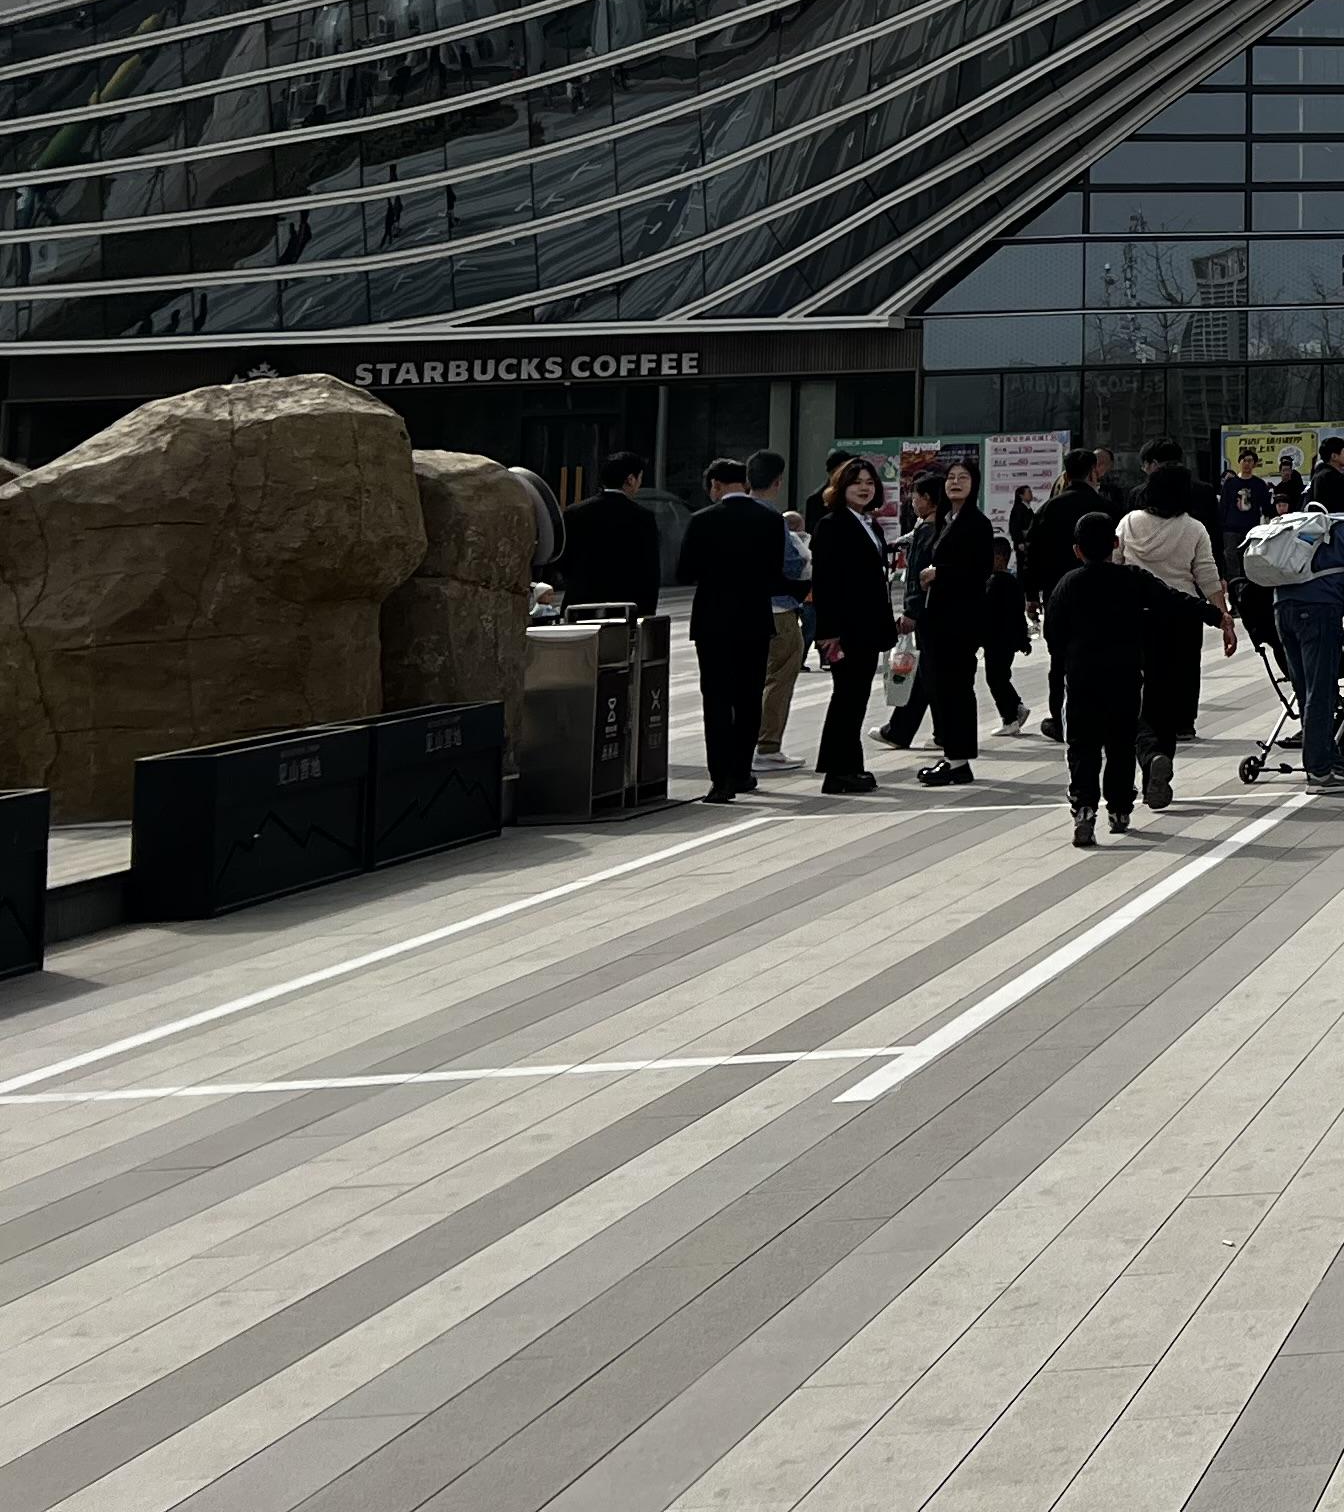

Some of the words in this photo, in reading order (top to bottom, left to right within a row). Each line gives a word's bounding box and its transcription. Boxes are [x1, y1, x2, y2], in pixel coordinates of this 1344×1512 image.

[355, 357, 563, 386] STARBUCKS
[571, 353, 699, 378] COFFEE
[902, 440, 940, 455] Beyond
